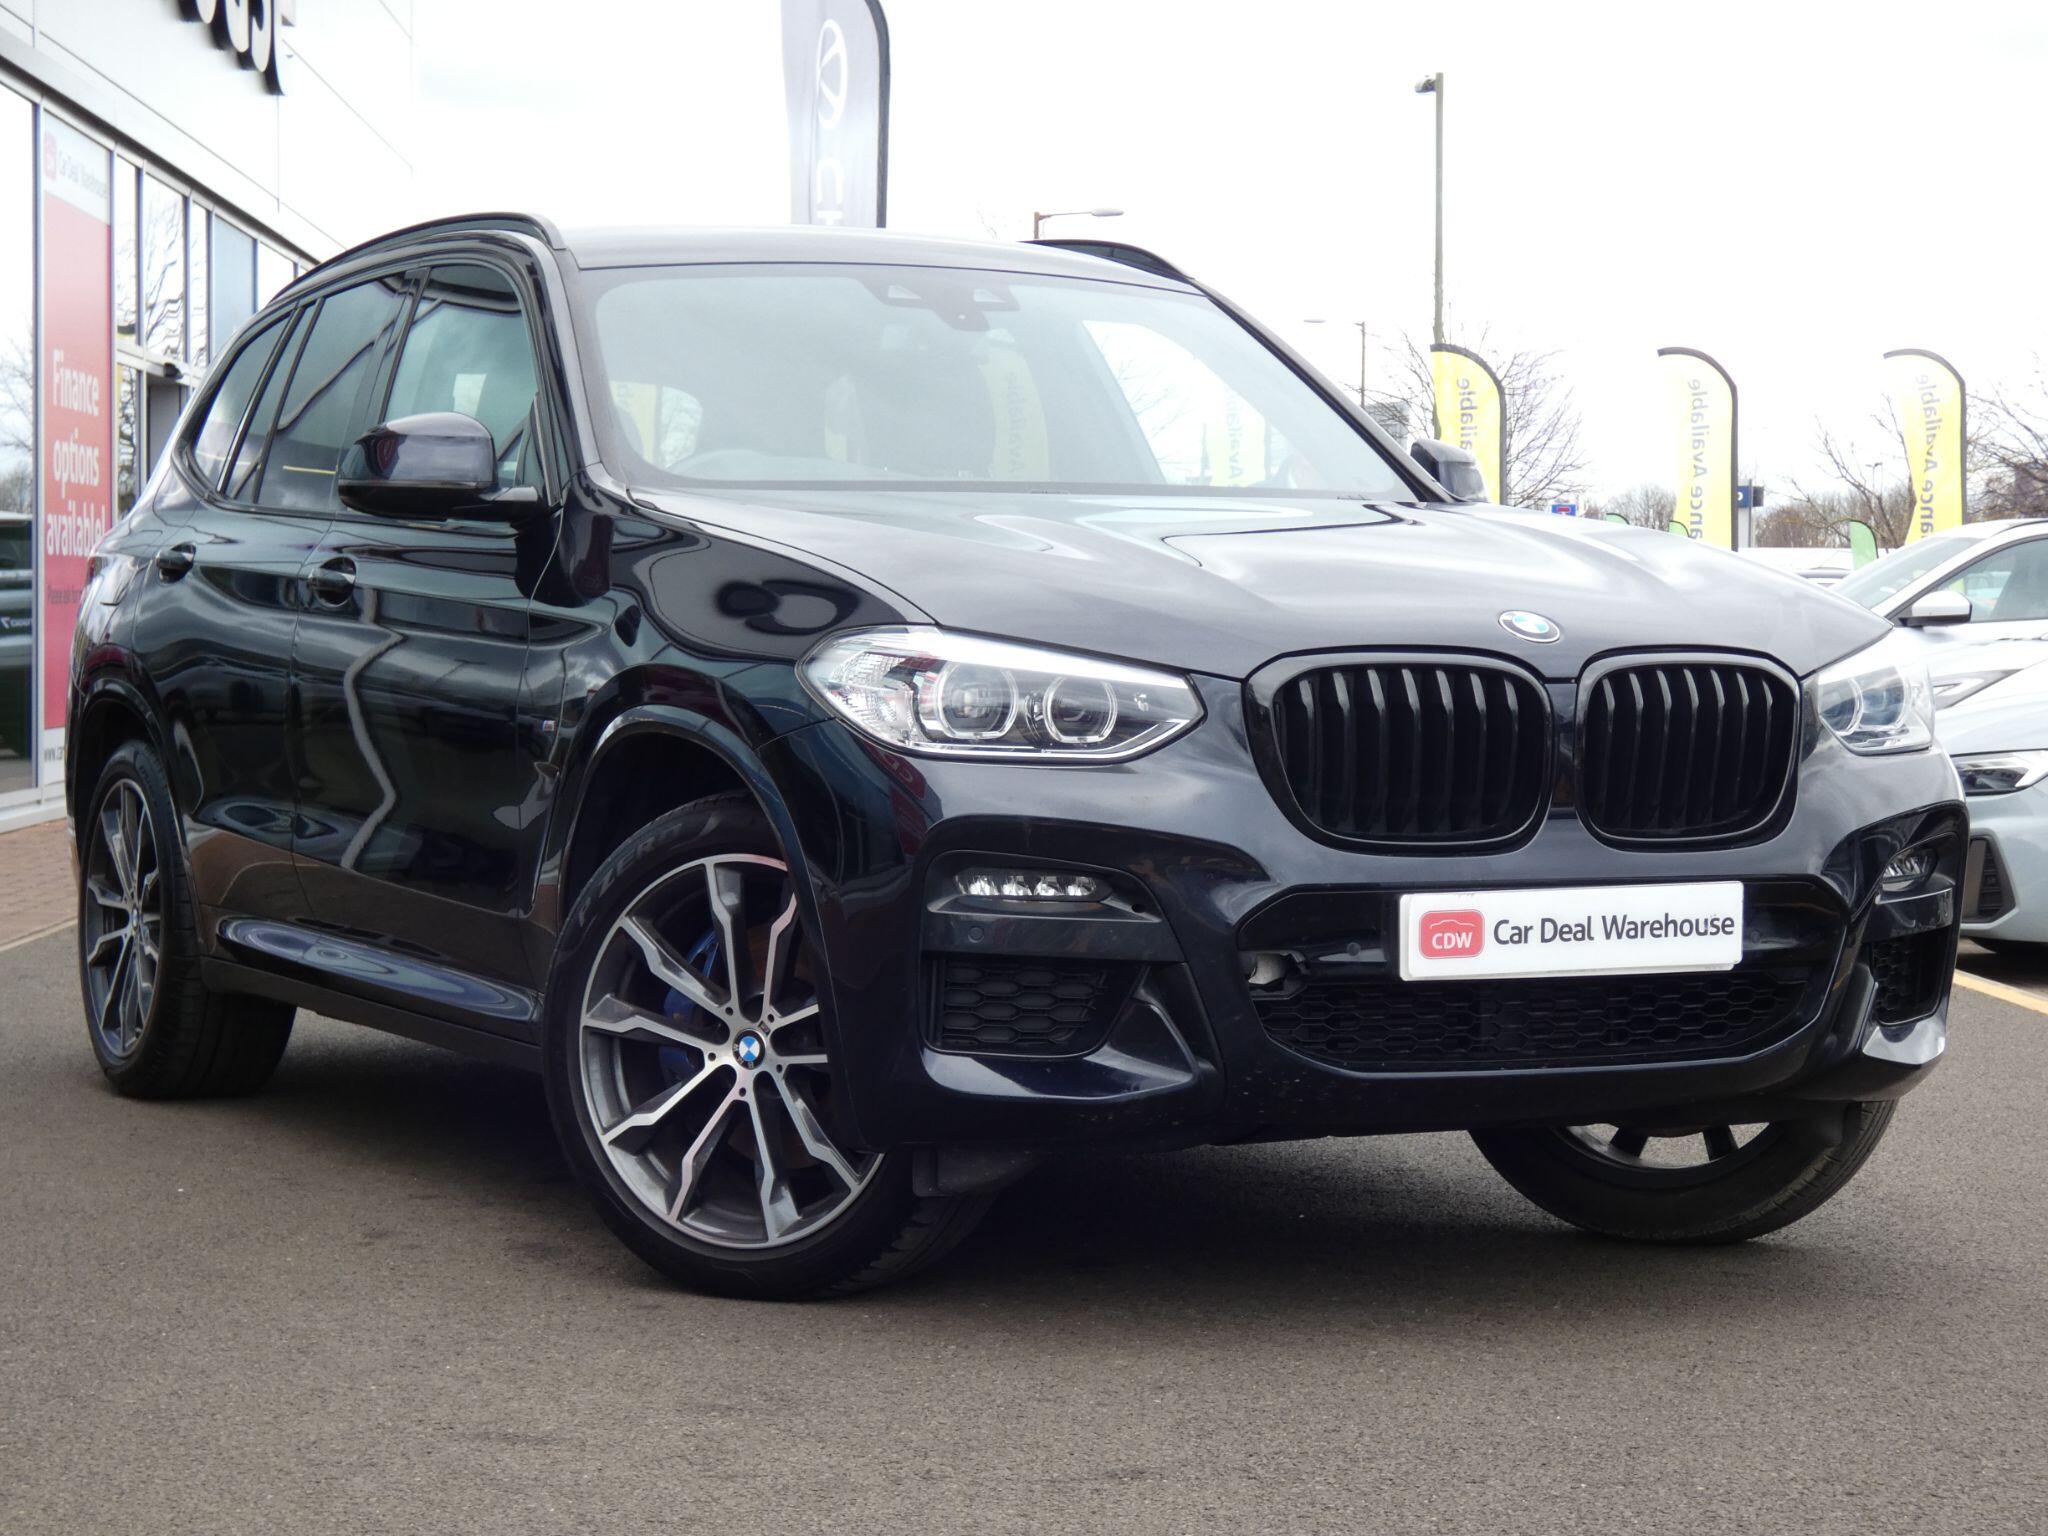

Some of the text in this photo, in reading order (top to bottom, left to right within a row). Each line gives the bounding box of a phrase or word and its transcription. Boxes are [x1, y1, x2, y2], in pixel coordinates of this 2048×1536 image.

[52, 349, 99, 417] Finance
[53, 428, 99, 498] options
[1432, 931, 1473, 950] CDW
[1493, 913, 1735, 945] Car Deal Warehouse
